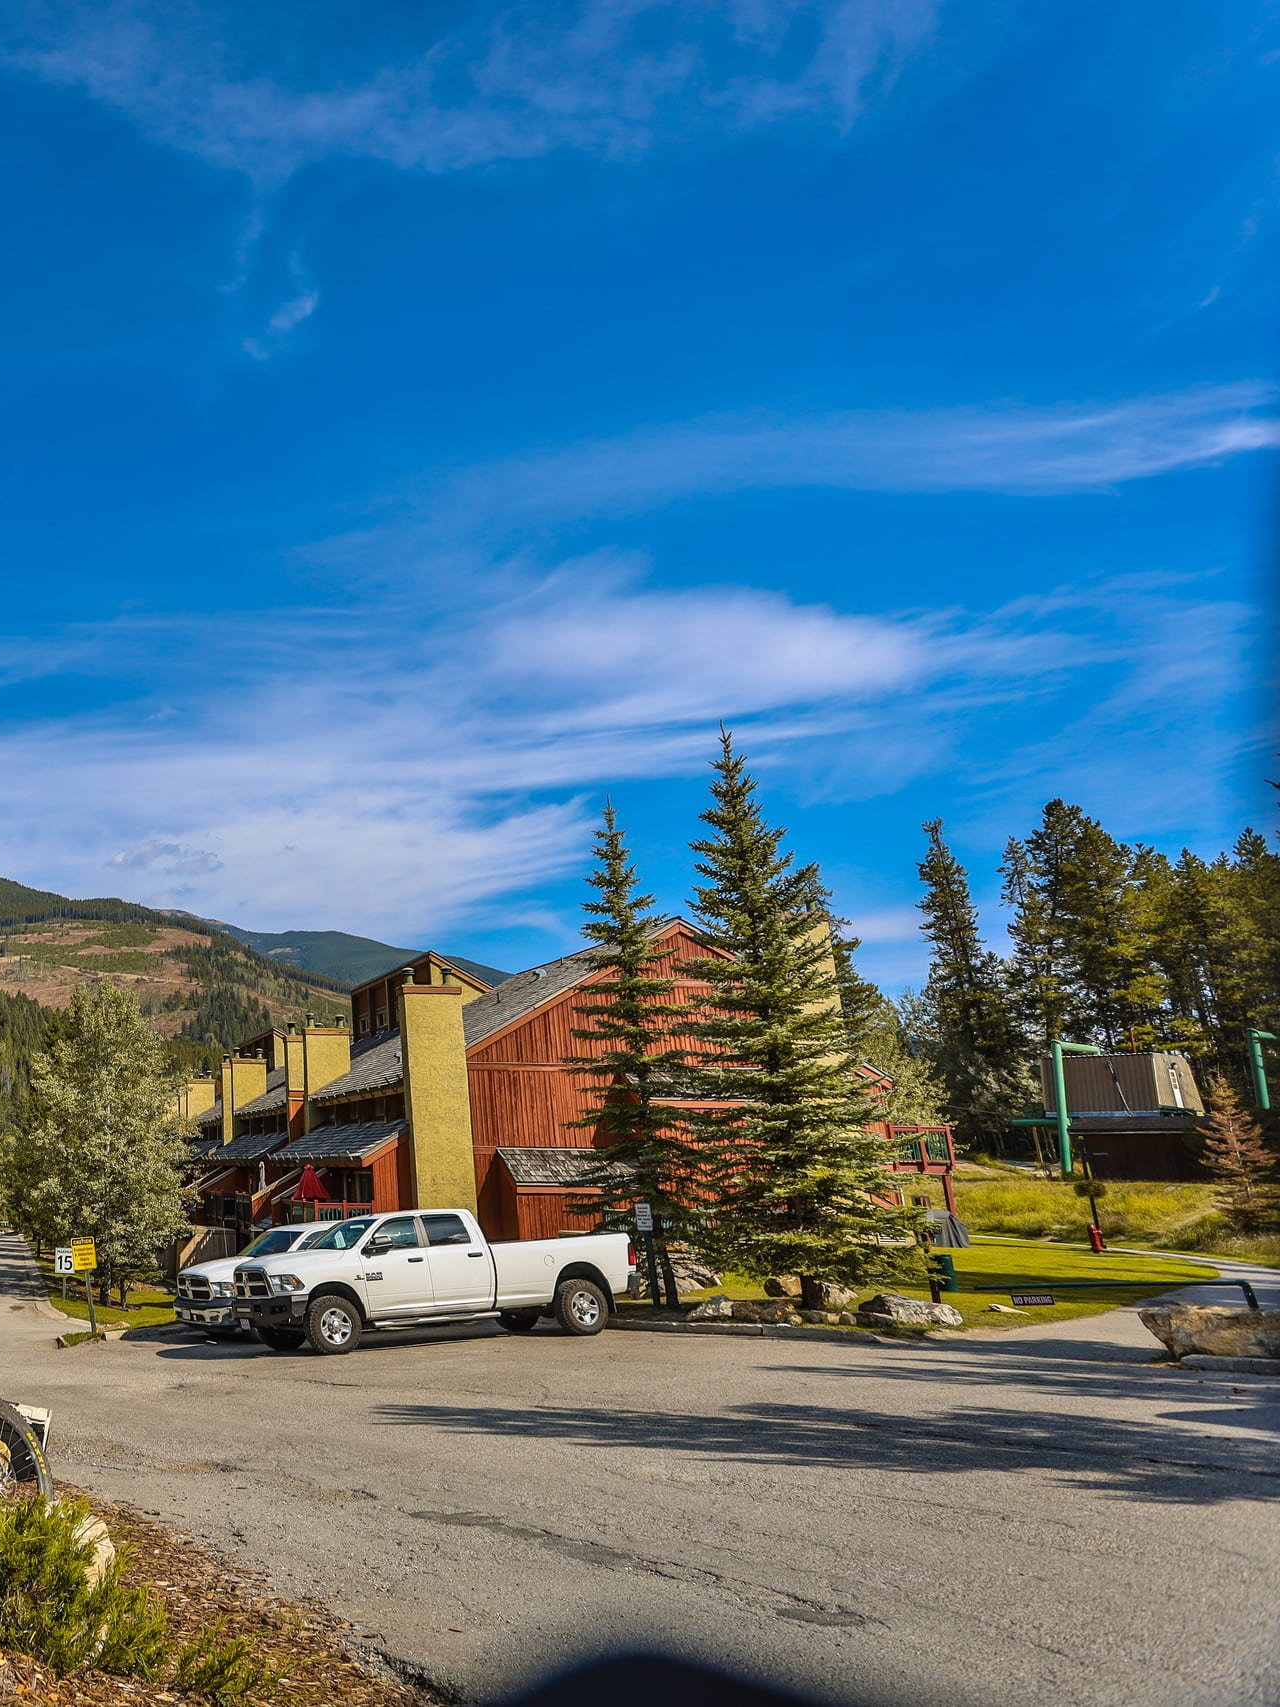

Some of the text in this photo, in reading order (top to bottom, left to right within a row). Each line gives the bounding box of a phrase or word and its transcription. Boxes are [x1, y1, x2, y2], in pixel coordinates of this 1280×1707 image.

[58, 1255, 73, 1270] 15
[1013, 1295, 1053, 1304] NO PARKING
